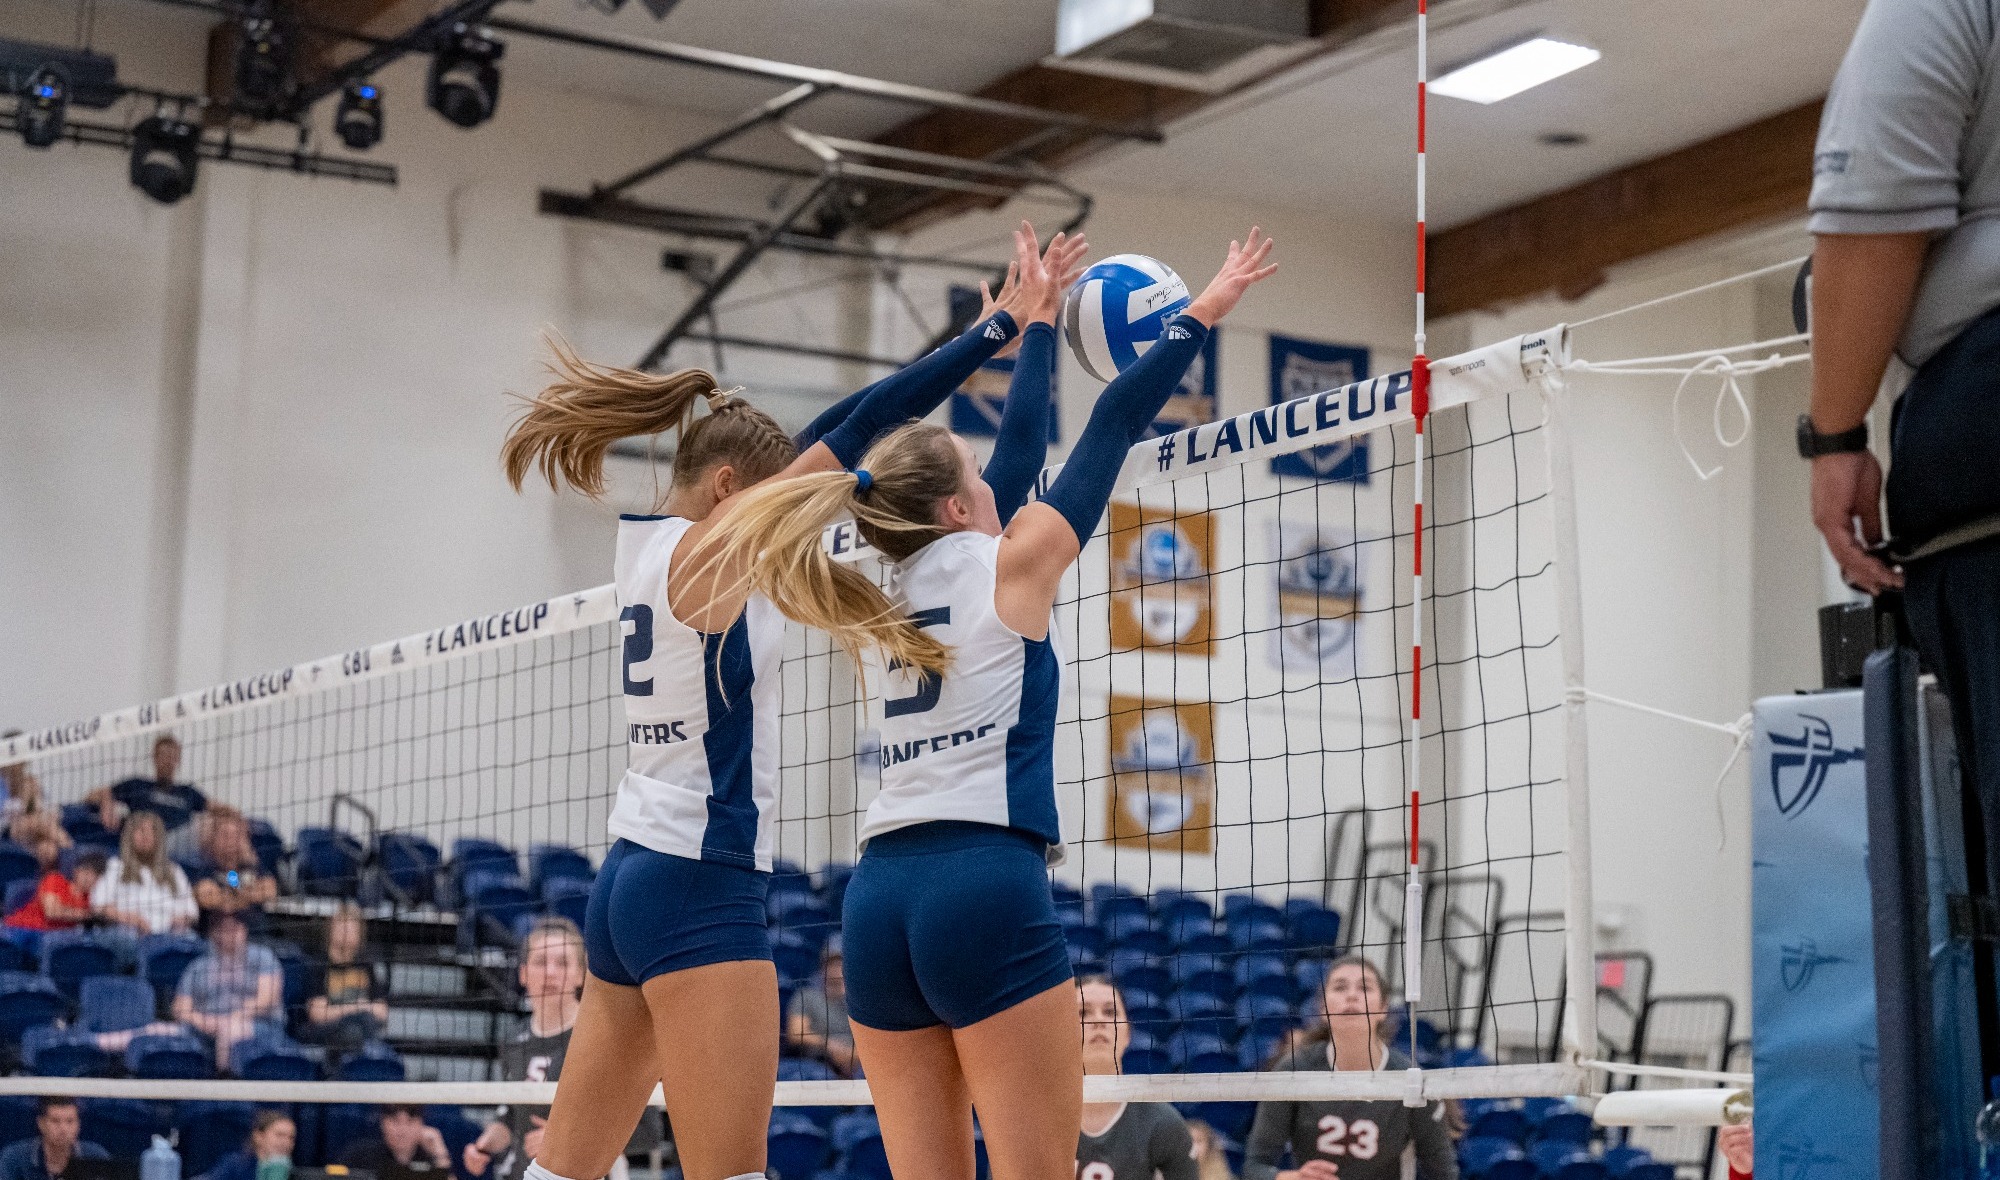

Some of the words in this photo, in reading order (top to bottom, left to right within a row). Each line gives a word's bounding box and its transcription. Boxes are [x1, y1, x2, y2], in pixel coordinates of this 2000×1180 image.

[1521, 338, 1546, 351] enoh
[1158, 369, 1413, 473] #LANCEUP
[619, 603, 654, 697] 2
[1316, 1114, 1380, 1160] 23
